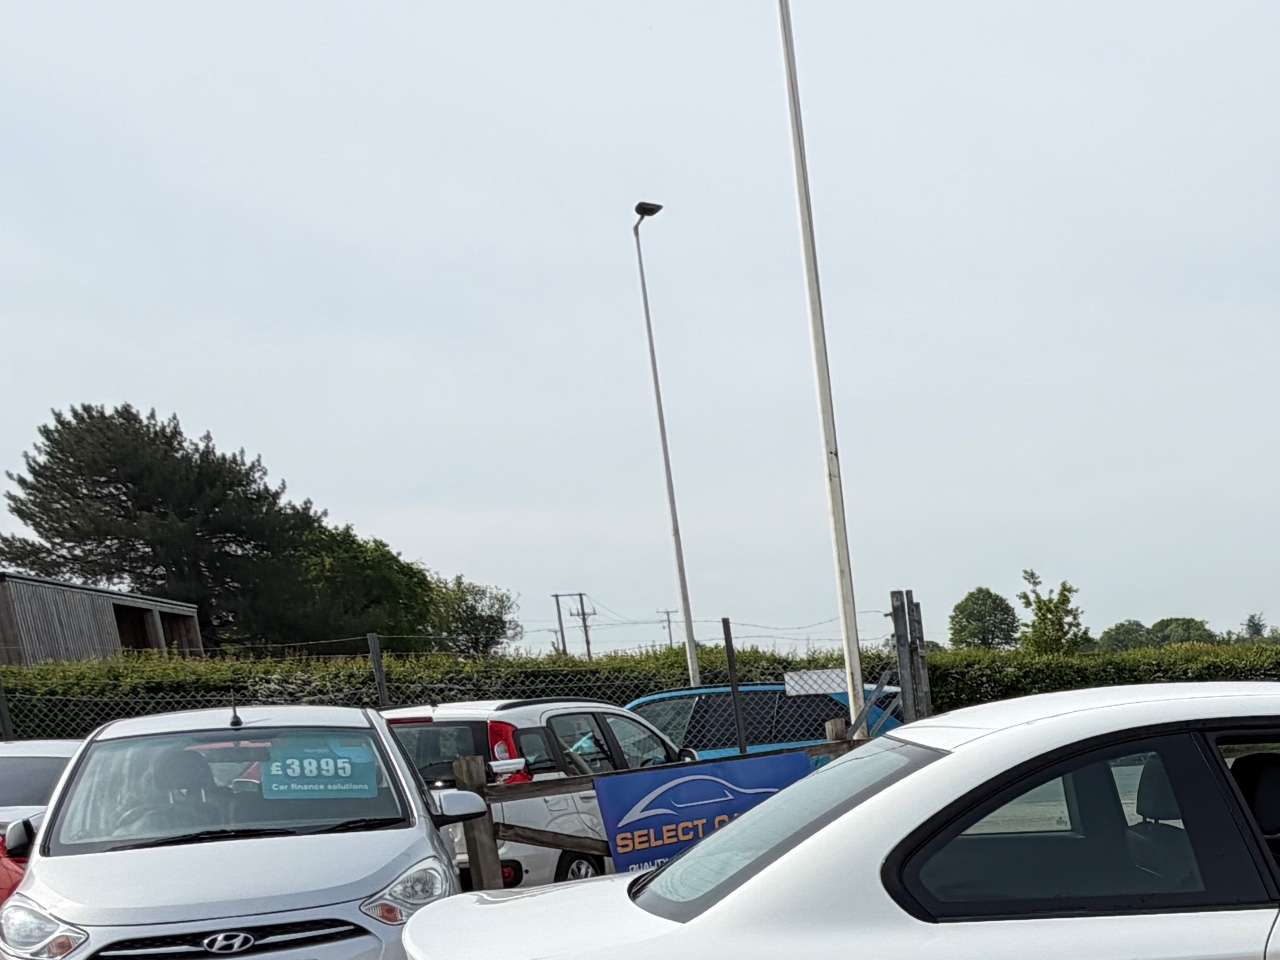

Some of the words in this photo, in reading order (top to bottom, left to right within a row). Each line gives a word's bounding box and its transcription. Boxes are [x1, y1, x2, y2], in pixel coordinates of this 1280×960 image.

[270, 758, 352, 777] £3895
[271, 783, 288, 791] Car
[290, 783, 325, 791] finance
[327, 782, 369, 790] solutions
[615, 818, 707, 854] SELECT
